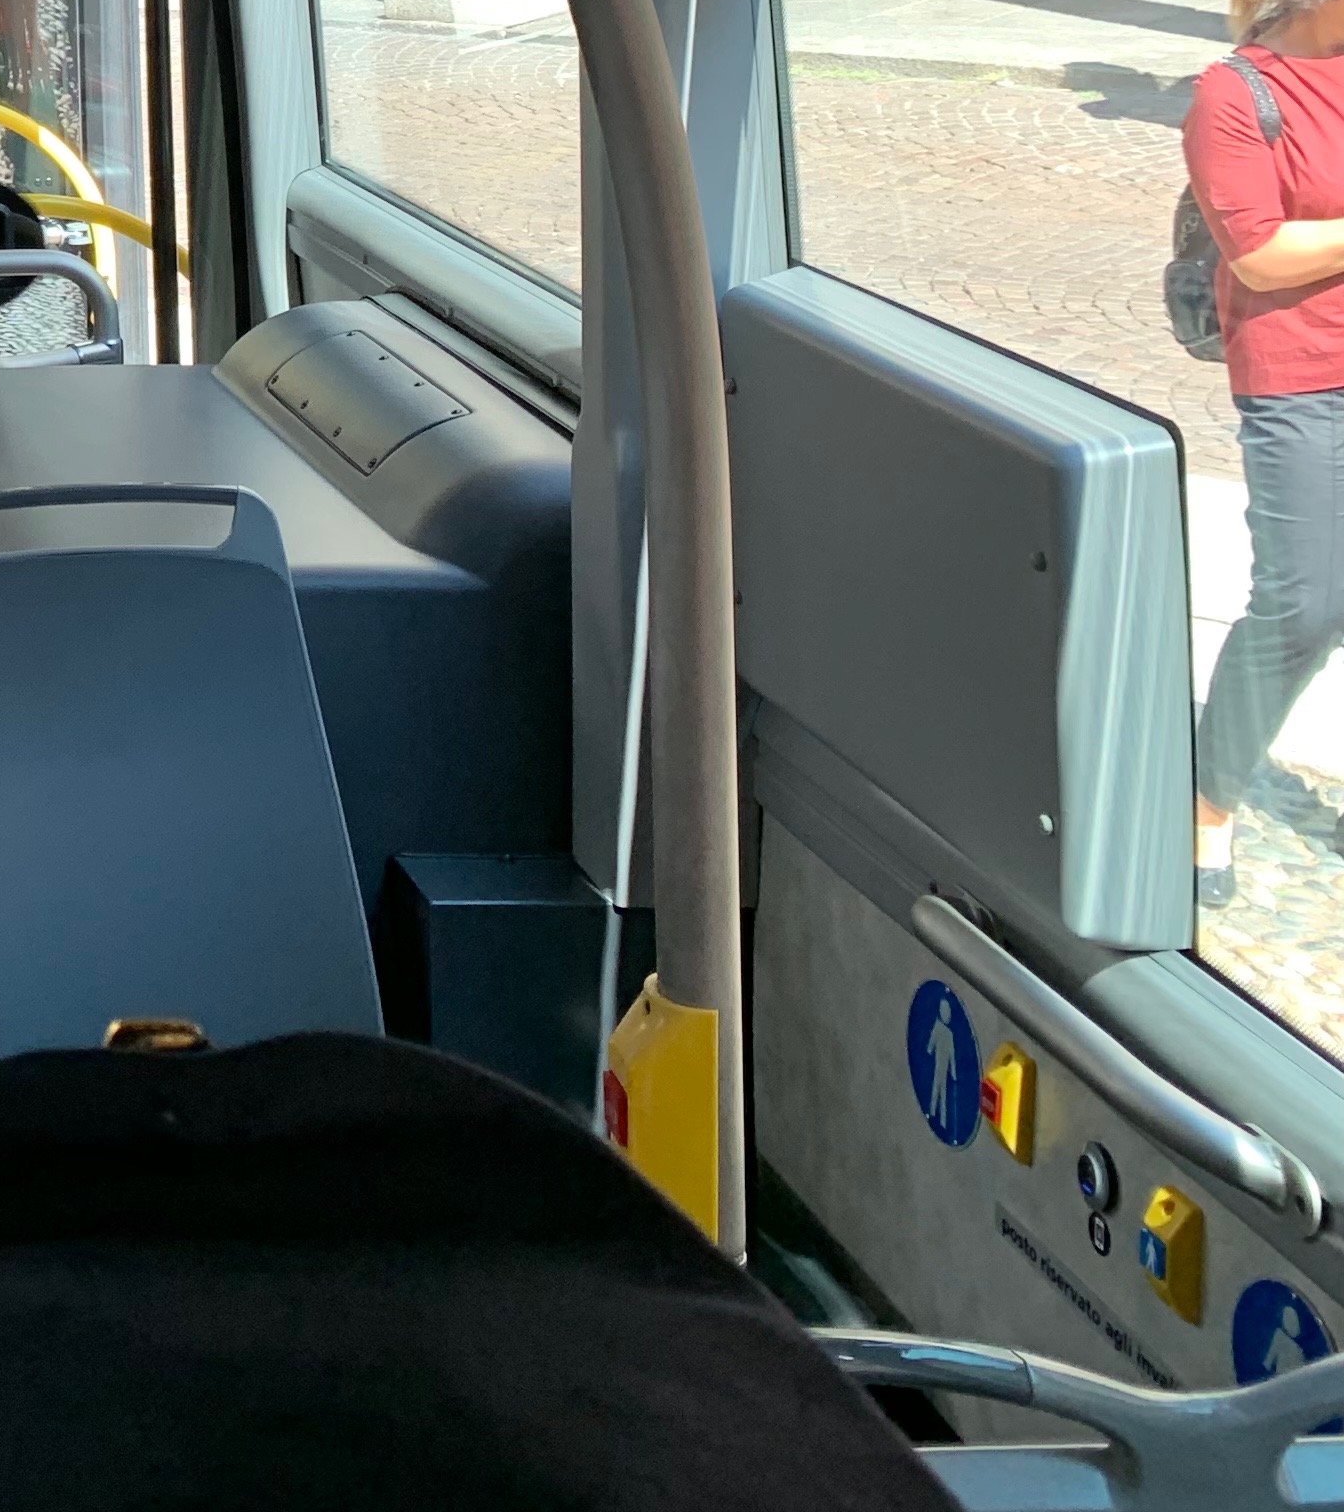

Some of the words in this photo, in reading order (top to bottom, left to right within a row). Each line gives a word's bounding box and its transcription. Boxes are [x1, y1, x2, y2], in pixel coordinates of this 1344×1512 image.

[1001, 1218, 1038, 1263] posto
[1040, 1255, 1102, 1326] riservato
[1105, 1320, 1133, 1358] agli
